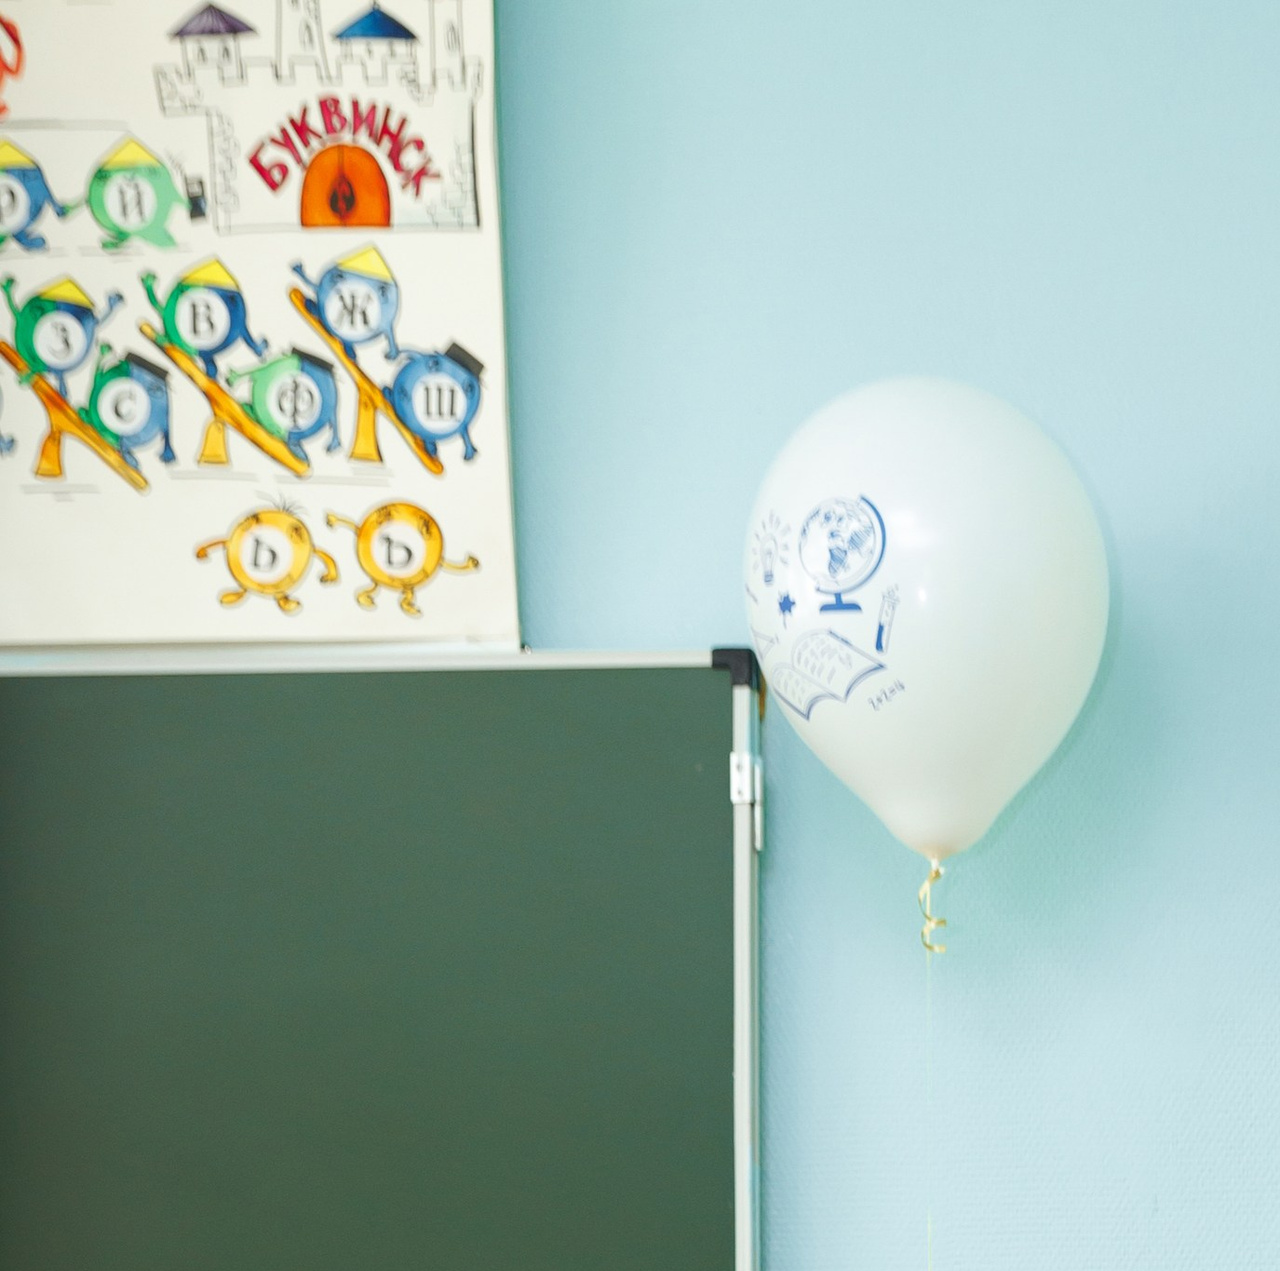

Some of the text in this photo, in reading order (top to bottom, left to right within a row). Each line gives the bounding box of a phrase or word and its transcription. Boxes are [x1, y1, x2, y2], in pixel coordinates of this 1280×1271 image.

[248, 94, 441, 198] БУКВИНСК
[190, 296, 215, 336] В
[333, 289, 375, 327] Ж
[113, 391, 138, 421] С
[277, 372, 316, 426] Ф
[422, 384, 460, 421] Ш
